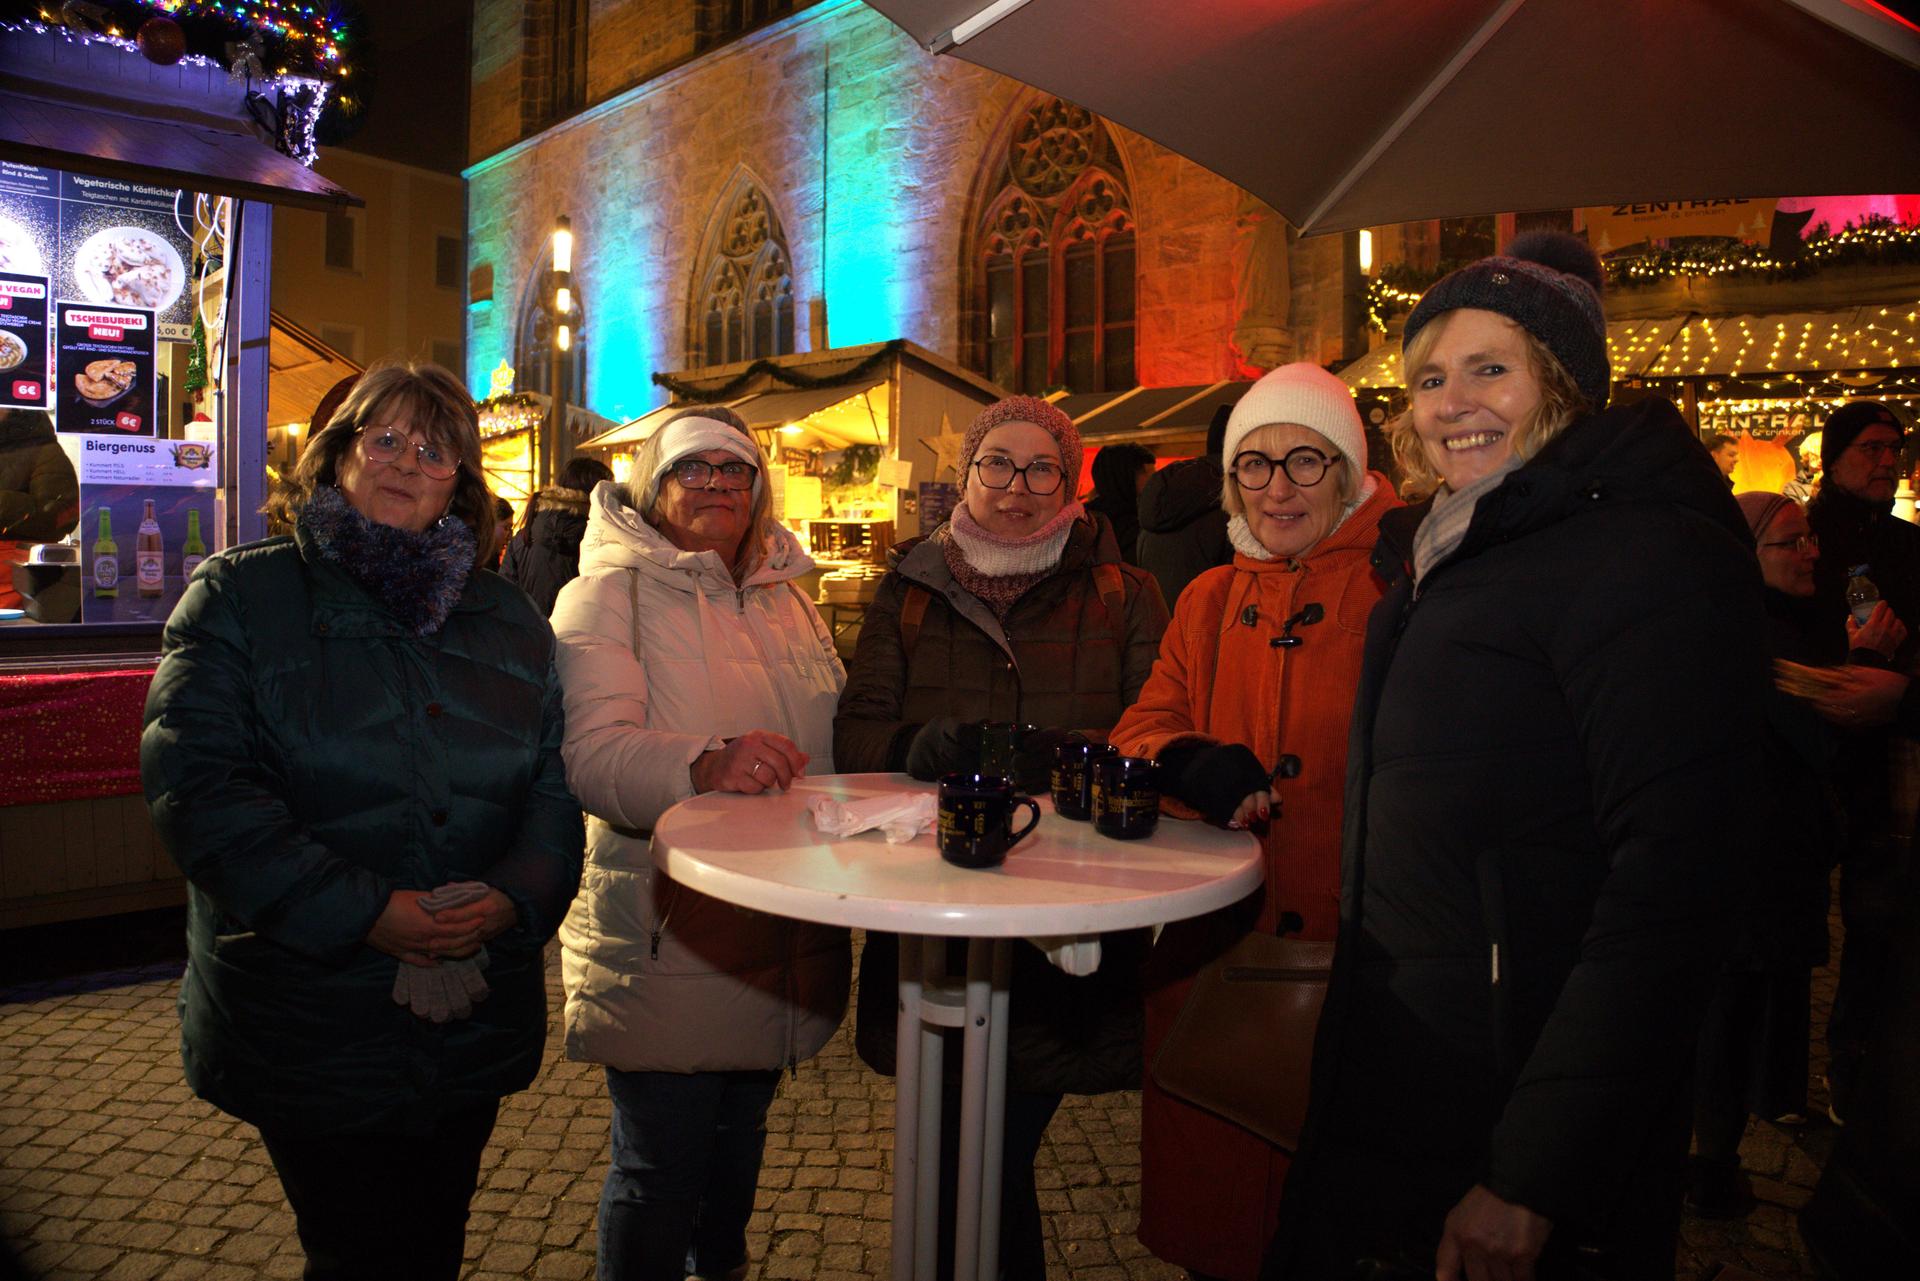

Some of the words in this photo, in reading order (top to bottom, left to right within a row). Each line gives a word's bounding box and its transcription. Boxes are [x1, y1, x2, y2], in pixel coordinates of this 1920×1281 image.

[2, 161, 39, 172] Putenfleisch
[23, 172, 48, 181] Schwein
[73, 176, 130, 191] Vegetarische
[82, 190, 118, 201] Teigtaschen
[6, 285, 41, 294] VEGAN
[70, 314, 143, 326] TSCHEBUREKI
[93, 327, 120, 338] NEU!
[182, 327, 189, 337] €
[18, 385, 36, 395] 6€
[96, 418, 115, 426] STÜCK
[121, 416, 137, 427] 6€
[1700, 414, 1825, 429] ZENTRAL
[86, 440, 156, 455] Biergenuss
